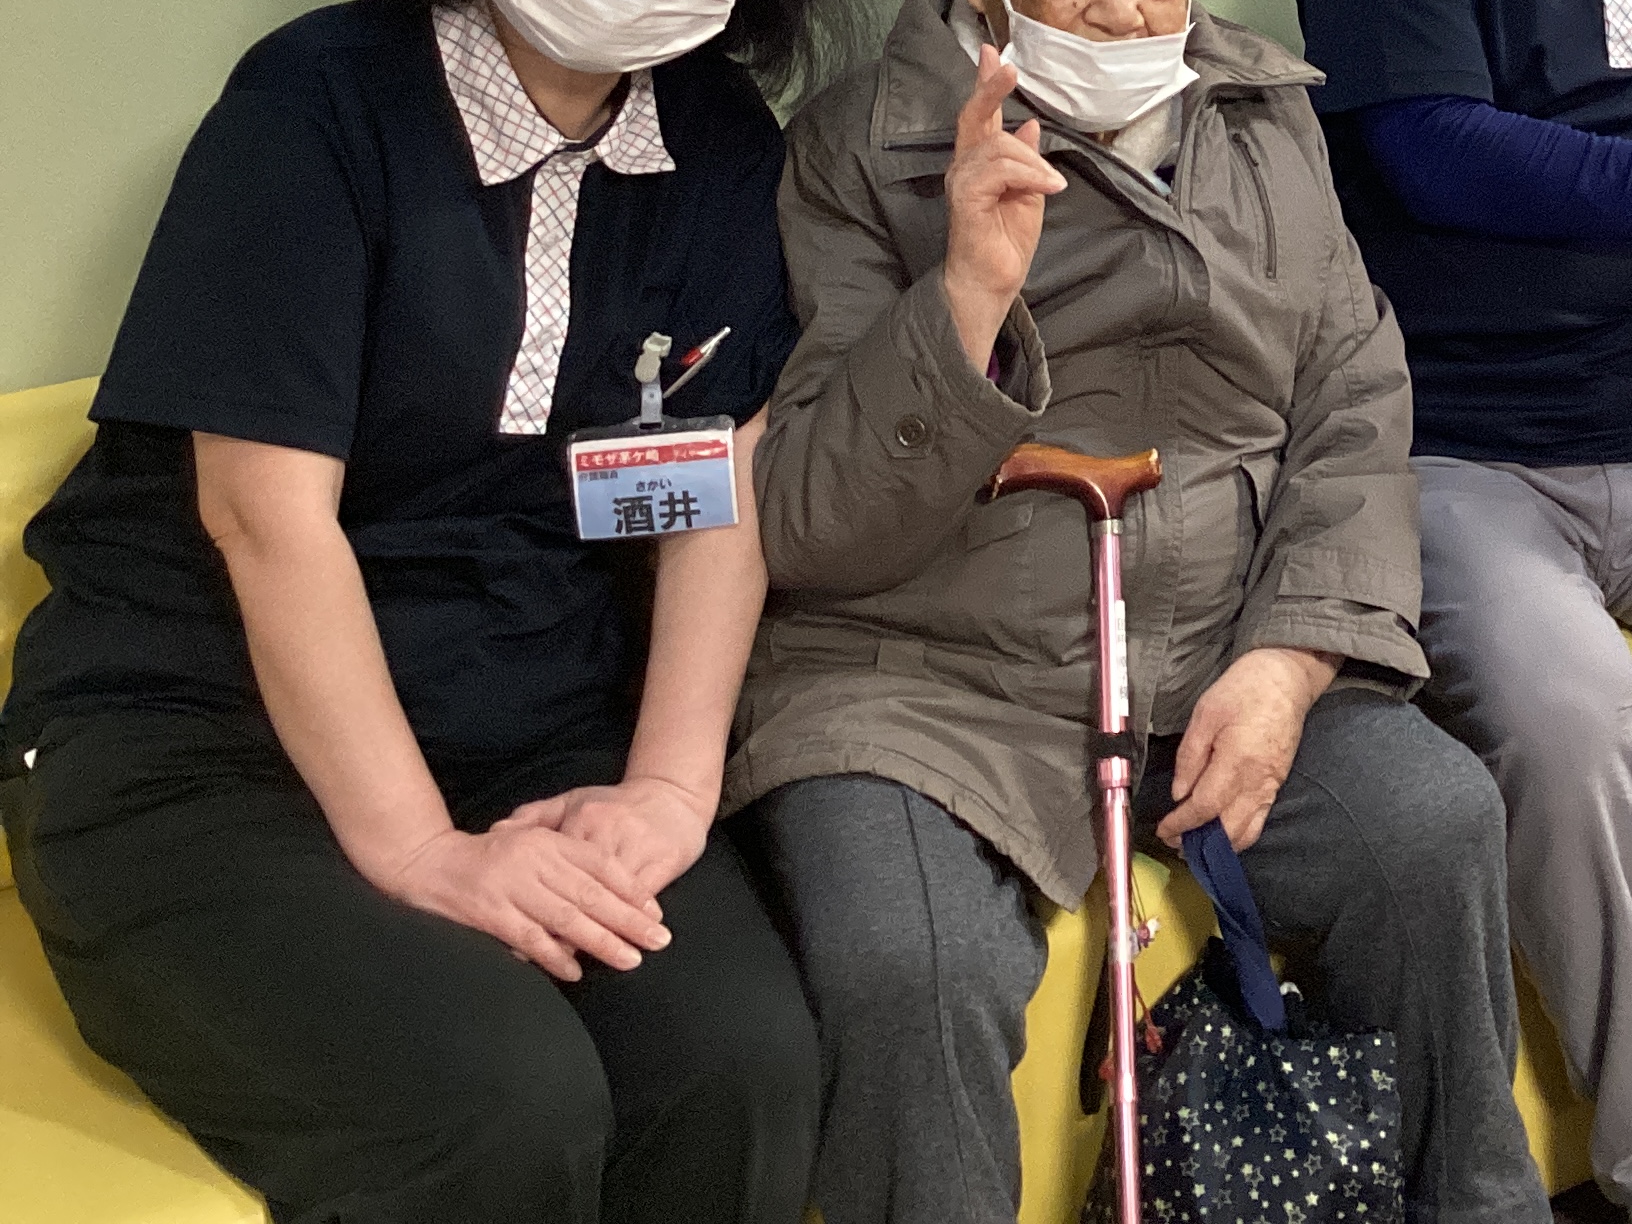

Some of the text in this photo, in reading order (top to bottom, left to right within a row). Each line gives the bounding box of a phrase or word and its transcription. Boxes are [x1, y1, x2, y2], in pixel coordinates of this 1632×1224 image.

[635, 477, 673, 493] さかい
[612, 489, 701, 535] 酒井
